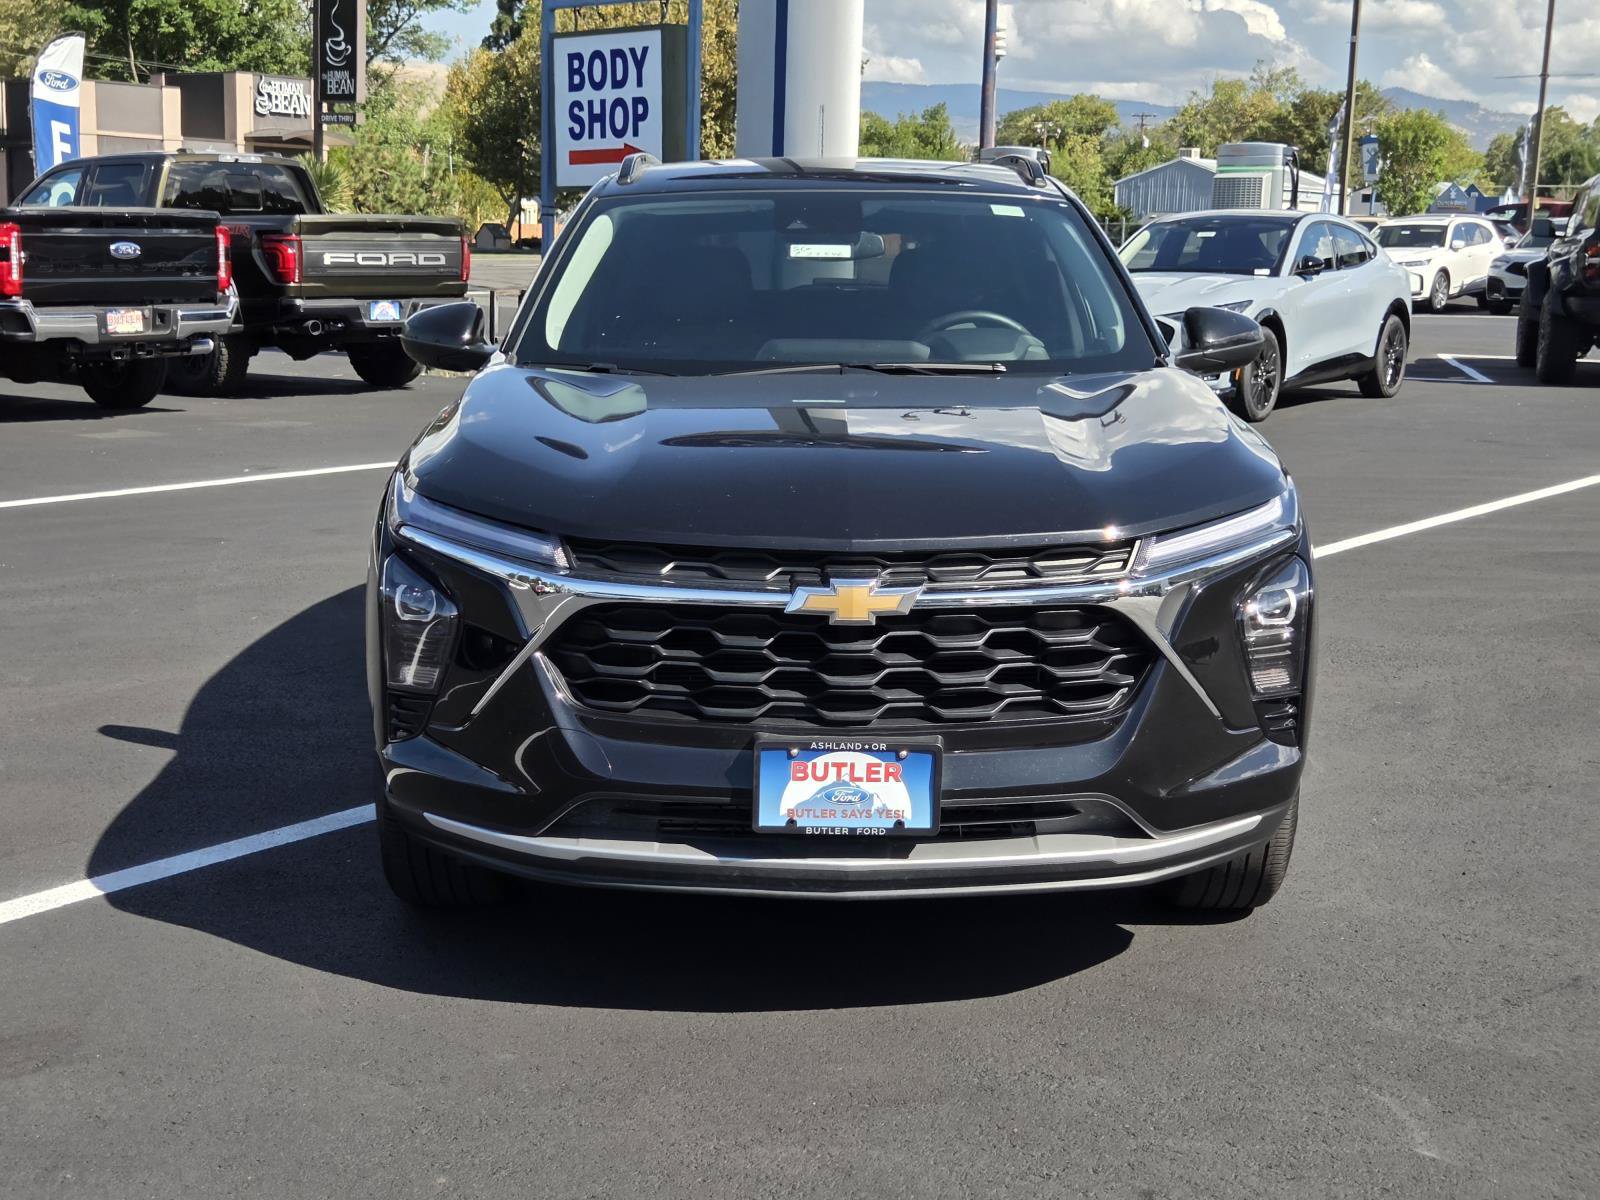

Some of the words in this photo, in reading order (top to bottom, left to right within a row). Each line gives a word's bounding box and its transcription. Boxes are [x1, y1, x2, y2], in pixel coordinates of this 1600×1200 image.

[327, 70, 350, 80] HUMAN
[567, 46, 649, 92] BODY
[44, 72, 69, 90] Ford
[272, 81, 304, 95] HUMAN
[327, 79, 355, 95] BEAN
[271, 93, 312, 116] BEAN
[567, 96, 649, 141] SHOP
[323, 252, 446, 266] FORD
[810, 742, 862, 750] ASHLAND
[871, 743, 887, 751] OR
[791, 761, 902, 783] BUTLER
[831, 789, 862, 803] Ford
[786, 808, 837, 819] BUTLER
[841, 808, 873, 819] SAYS
[877, 808, 905, 819] YES!
[805, 827, 849, 835] BUTLER
[856, 828, 886, 836] FORD
